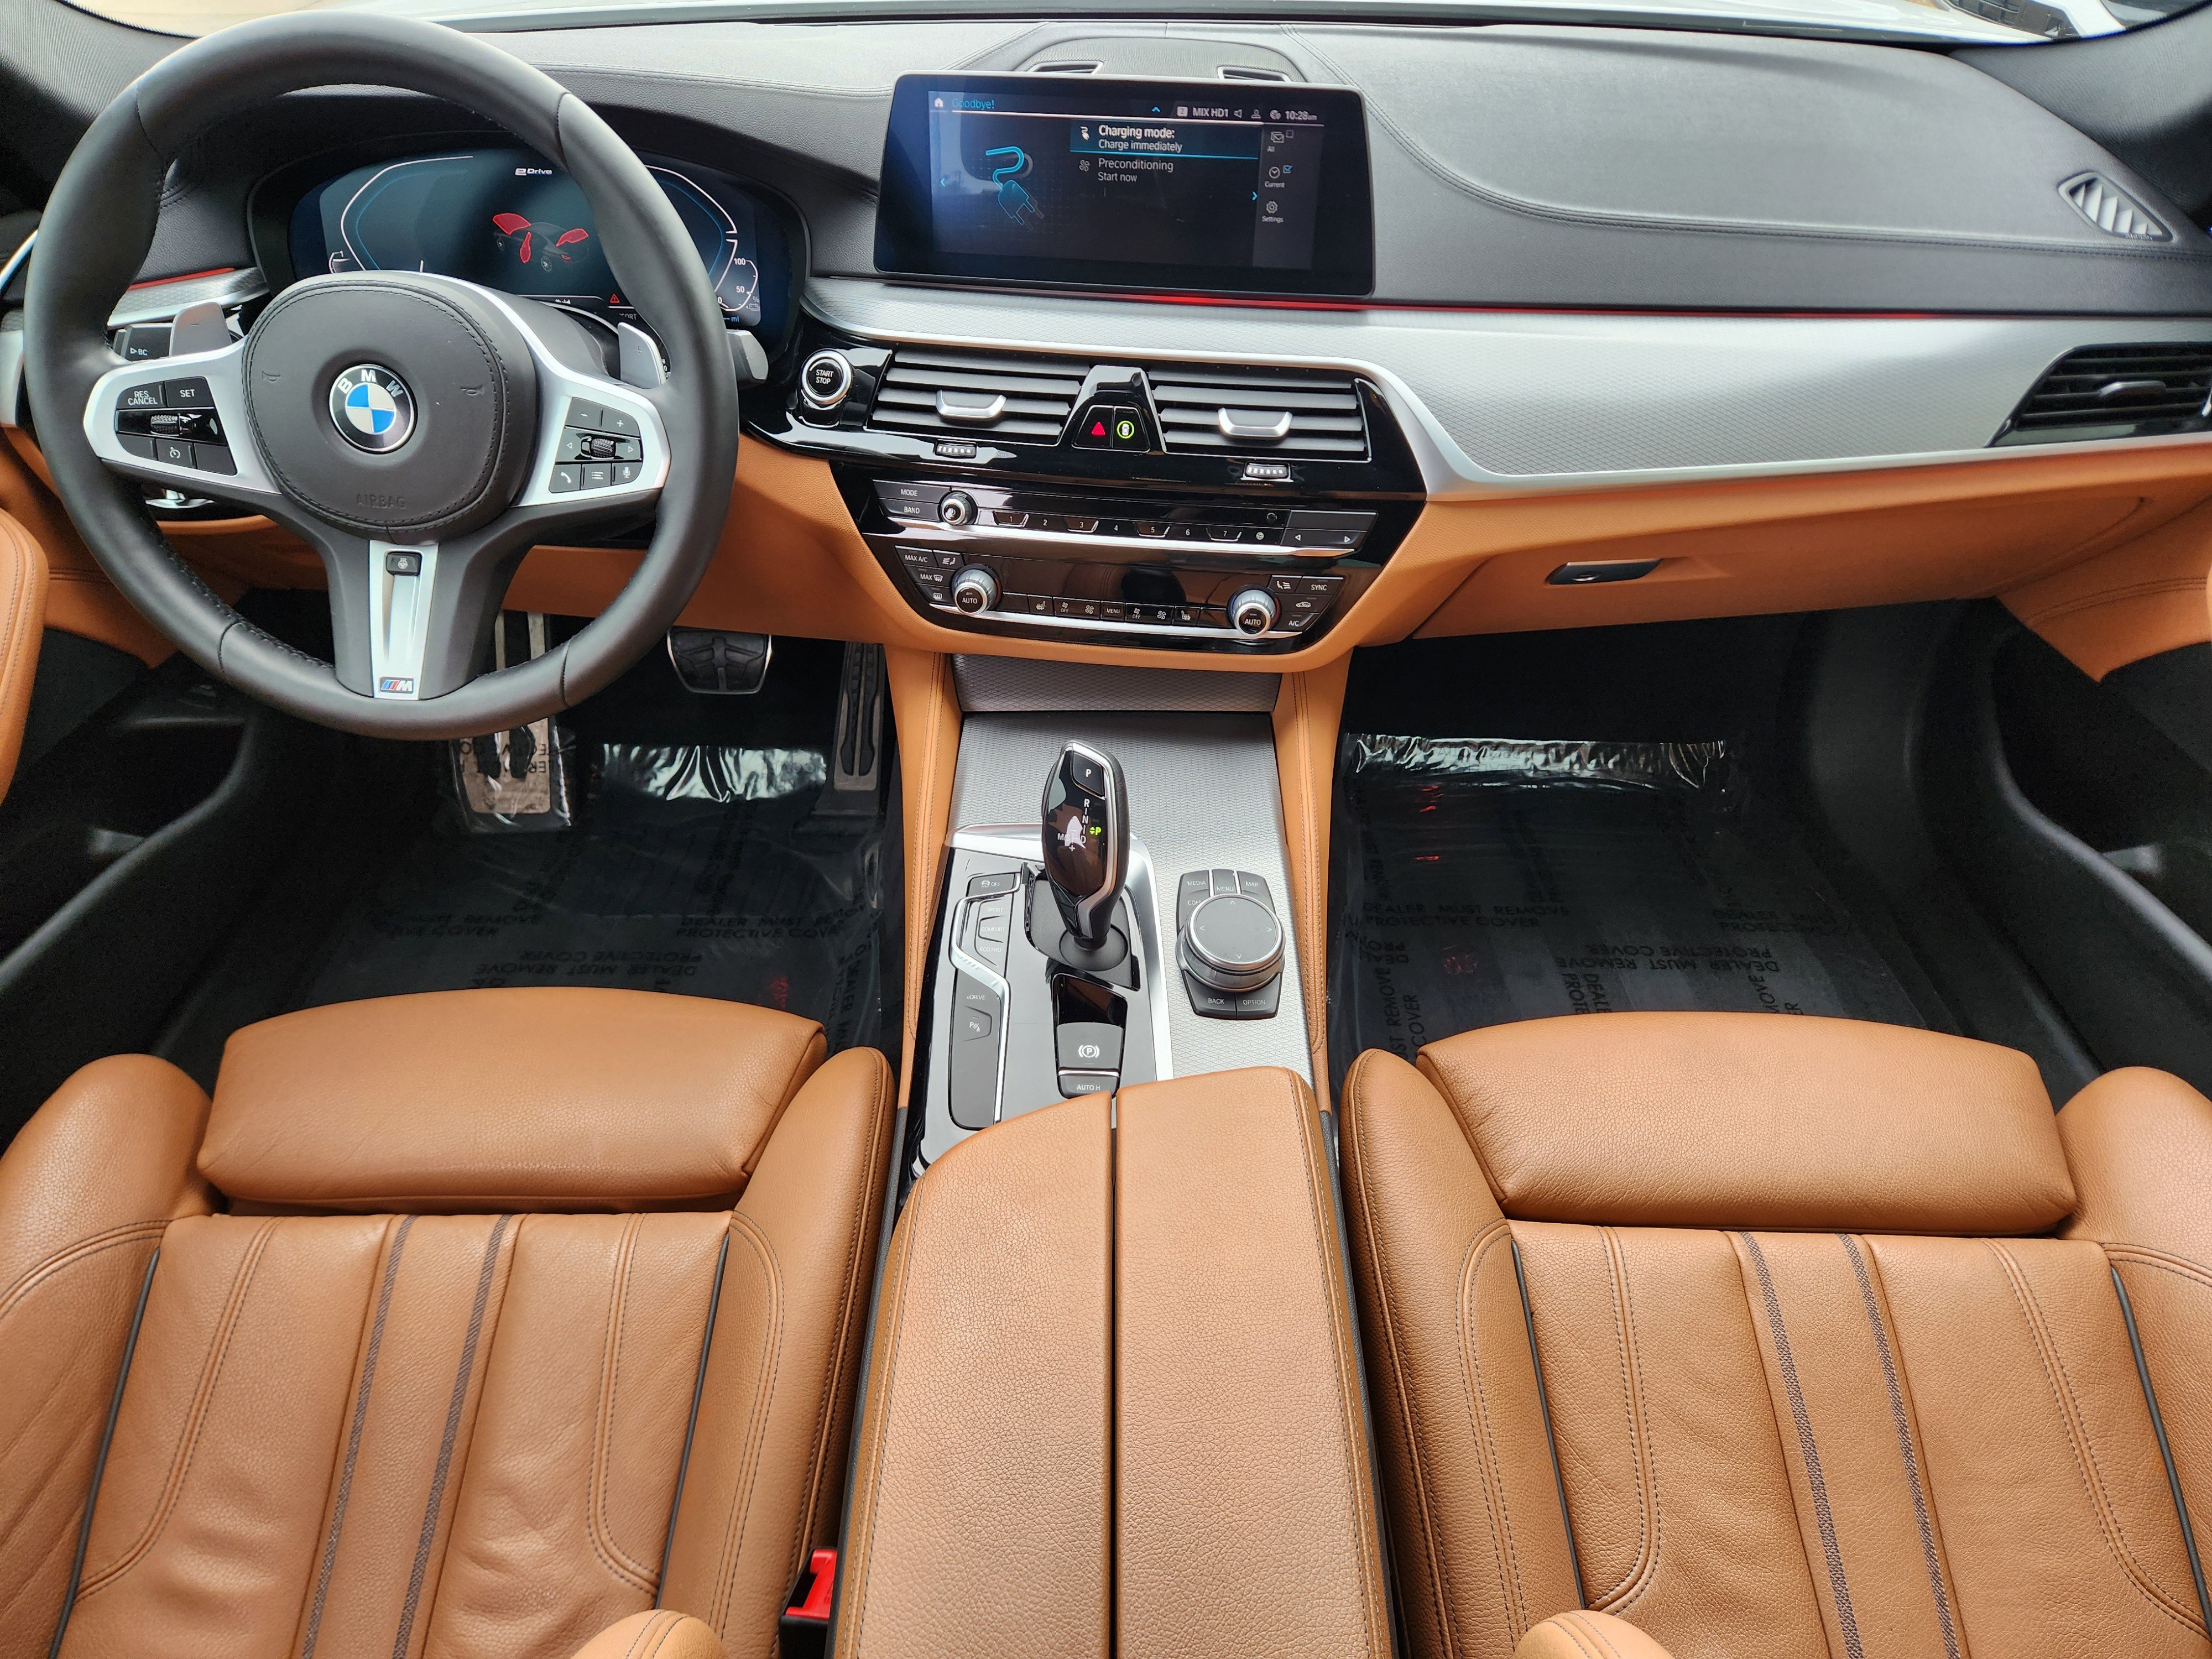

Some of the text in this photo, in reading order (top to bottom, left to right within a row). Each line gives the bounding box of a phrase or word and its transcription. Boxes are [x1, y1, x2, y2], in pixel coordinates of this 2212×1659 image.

[952, 98, 994, 110] Goodbye!
[1193, 107, 1229, 117] MIX HD1
[1098, 125, 1175, 139] Charging mode:
[1098, 139, 1183, 153] Charge immediately
[1098, 158, 1173, 173] Preconditioning
[1098, 172, 1118, 181] Start
[816, 369, 834, 378] START
[337, 369, 404, 398] BMW
[816, 376, 831, 384] STOP
[134, 390, 149, 398] RES
[180, 389, 195, 398] SET
[128, 397, 158, 406] CANCEL
[900, 488, 918, 497] MODE
[919, 555, 928, 563] A/C
[1288, 619, 1300, 628] A/C
[1085, 768, 1092, 778] P
[1084, 798, 1091, 808] R
[1082, 815, 1089, 824] N
[1081, 835, 1087, 844] D
[1375, 967, 1402, 1027] REMOVE
[1402, 994, 1427, 1047] COVER
